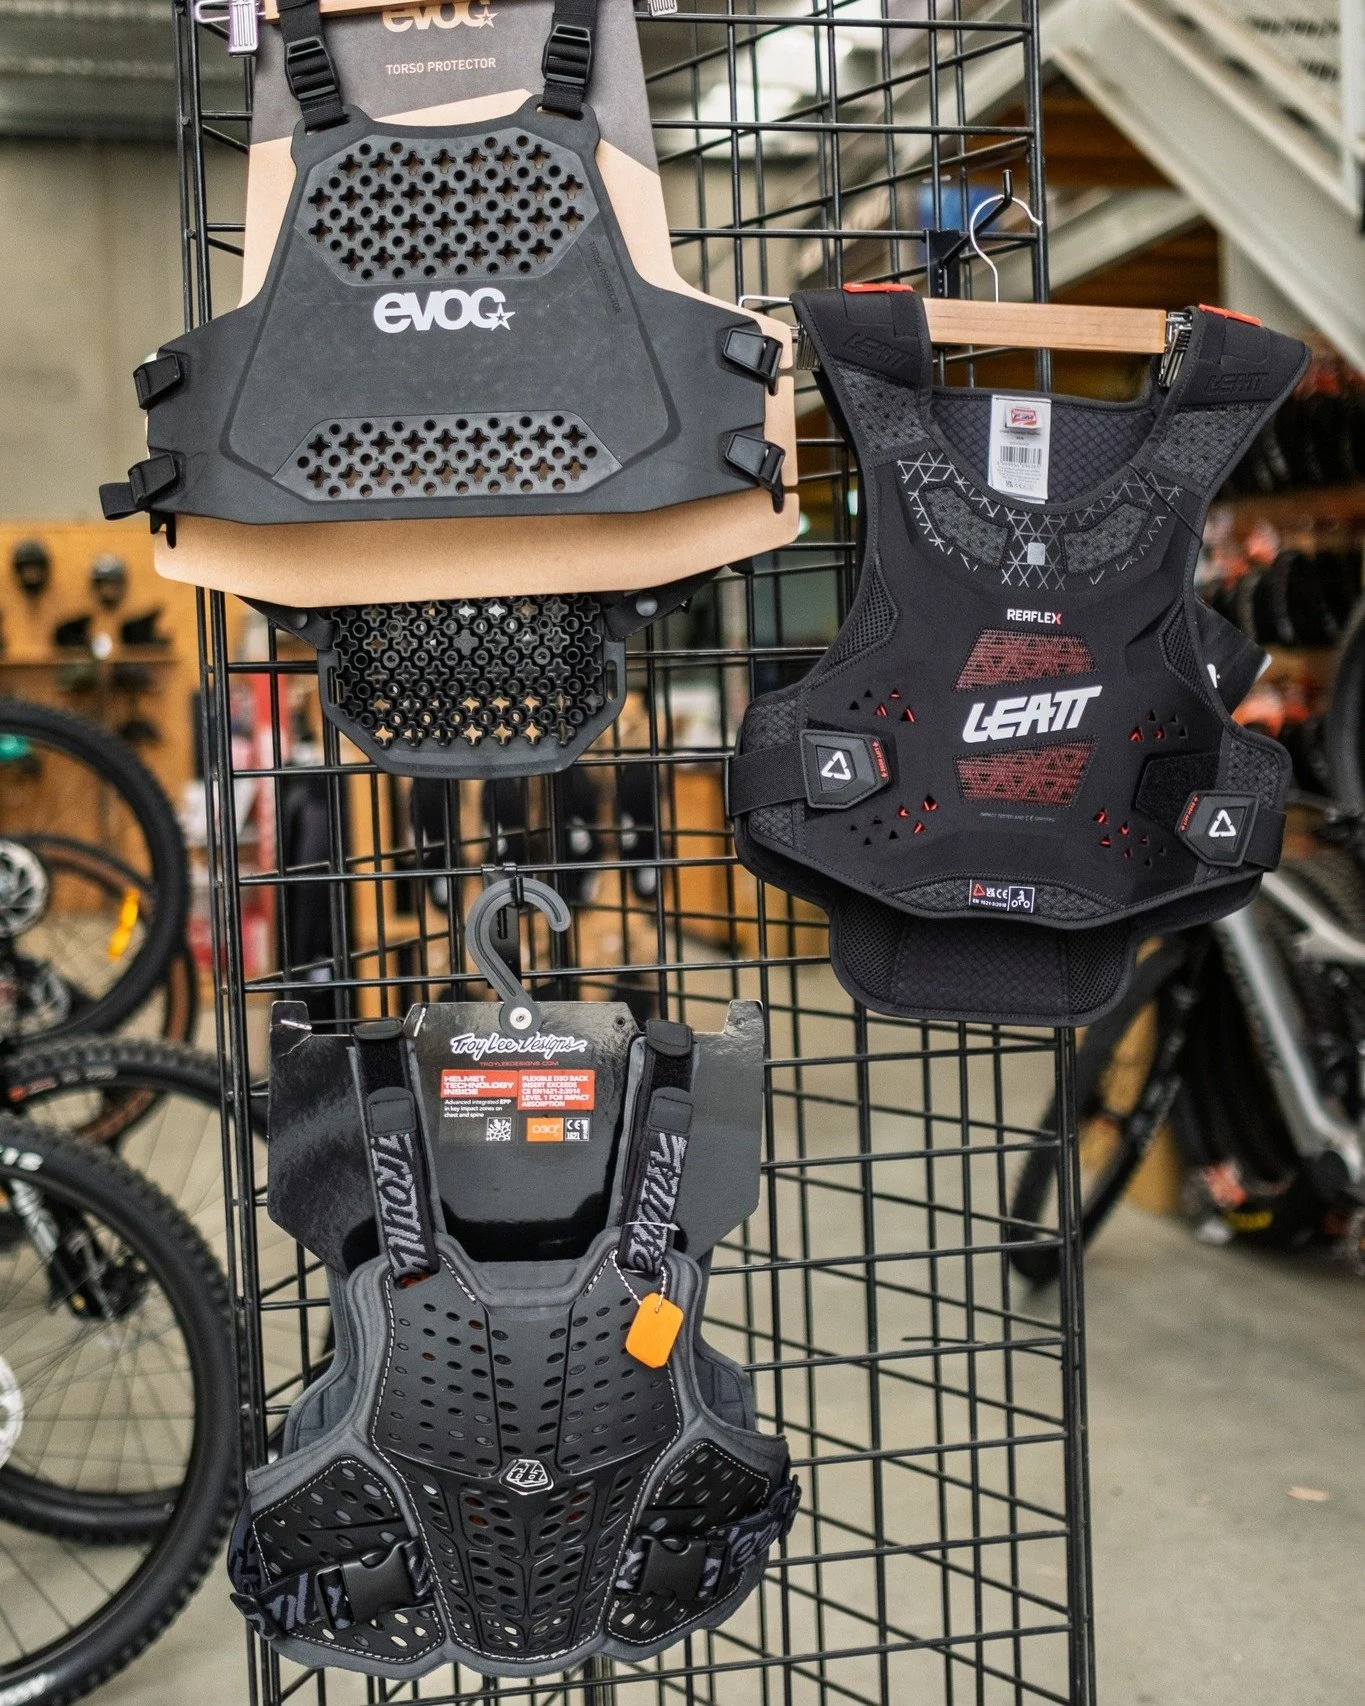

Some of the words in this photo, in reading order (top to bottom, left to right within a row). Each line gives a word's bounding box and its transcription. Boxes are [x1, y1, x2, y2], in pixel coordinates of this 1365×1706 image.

[385, 63, 424, 75] TORSO
[427, 57, 497, 72] PROTECTOR
[588, 240, 603, 267] TORSO
[599, 268, 621, 314] PROTECTOR
[1006, 608, 1062, 625] REAFLEX
[962, 685, 1103, 744] LEATT
[450, 1032, 486, 1061] Troy
[487, 1032, 517, 1053] Lee
[517, 1032, 587, 1060] Designs
[566, 1131, 580, 1139] 1621
